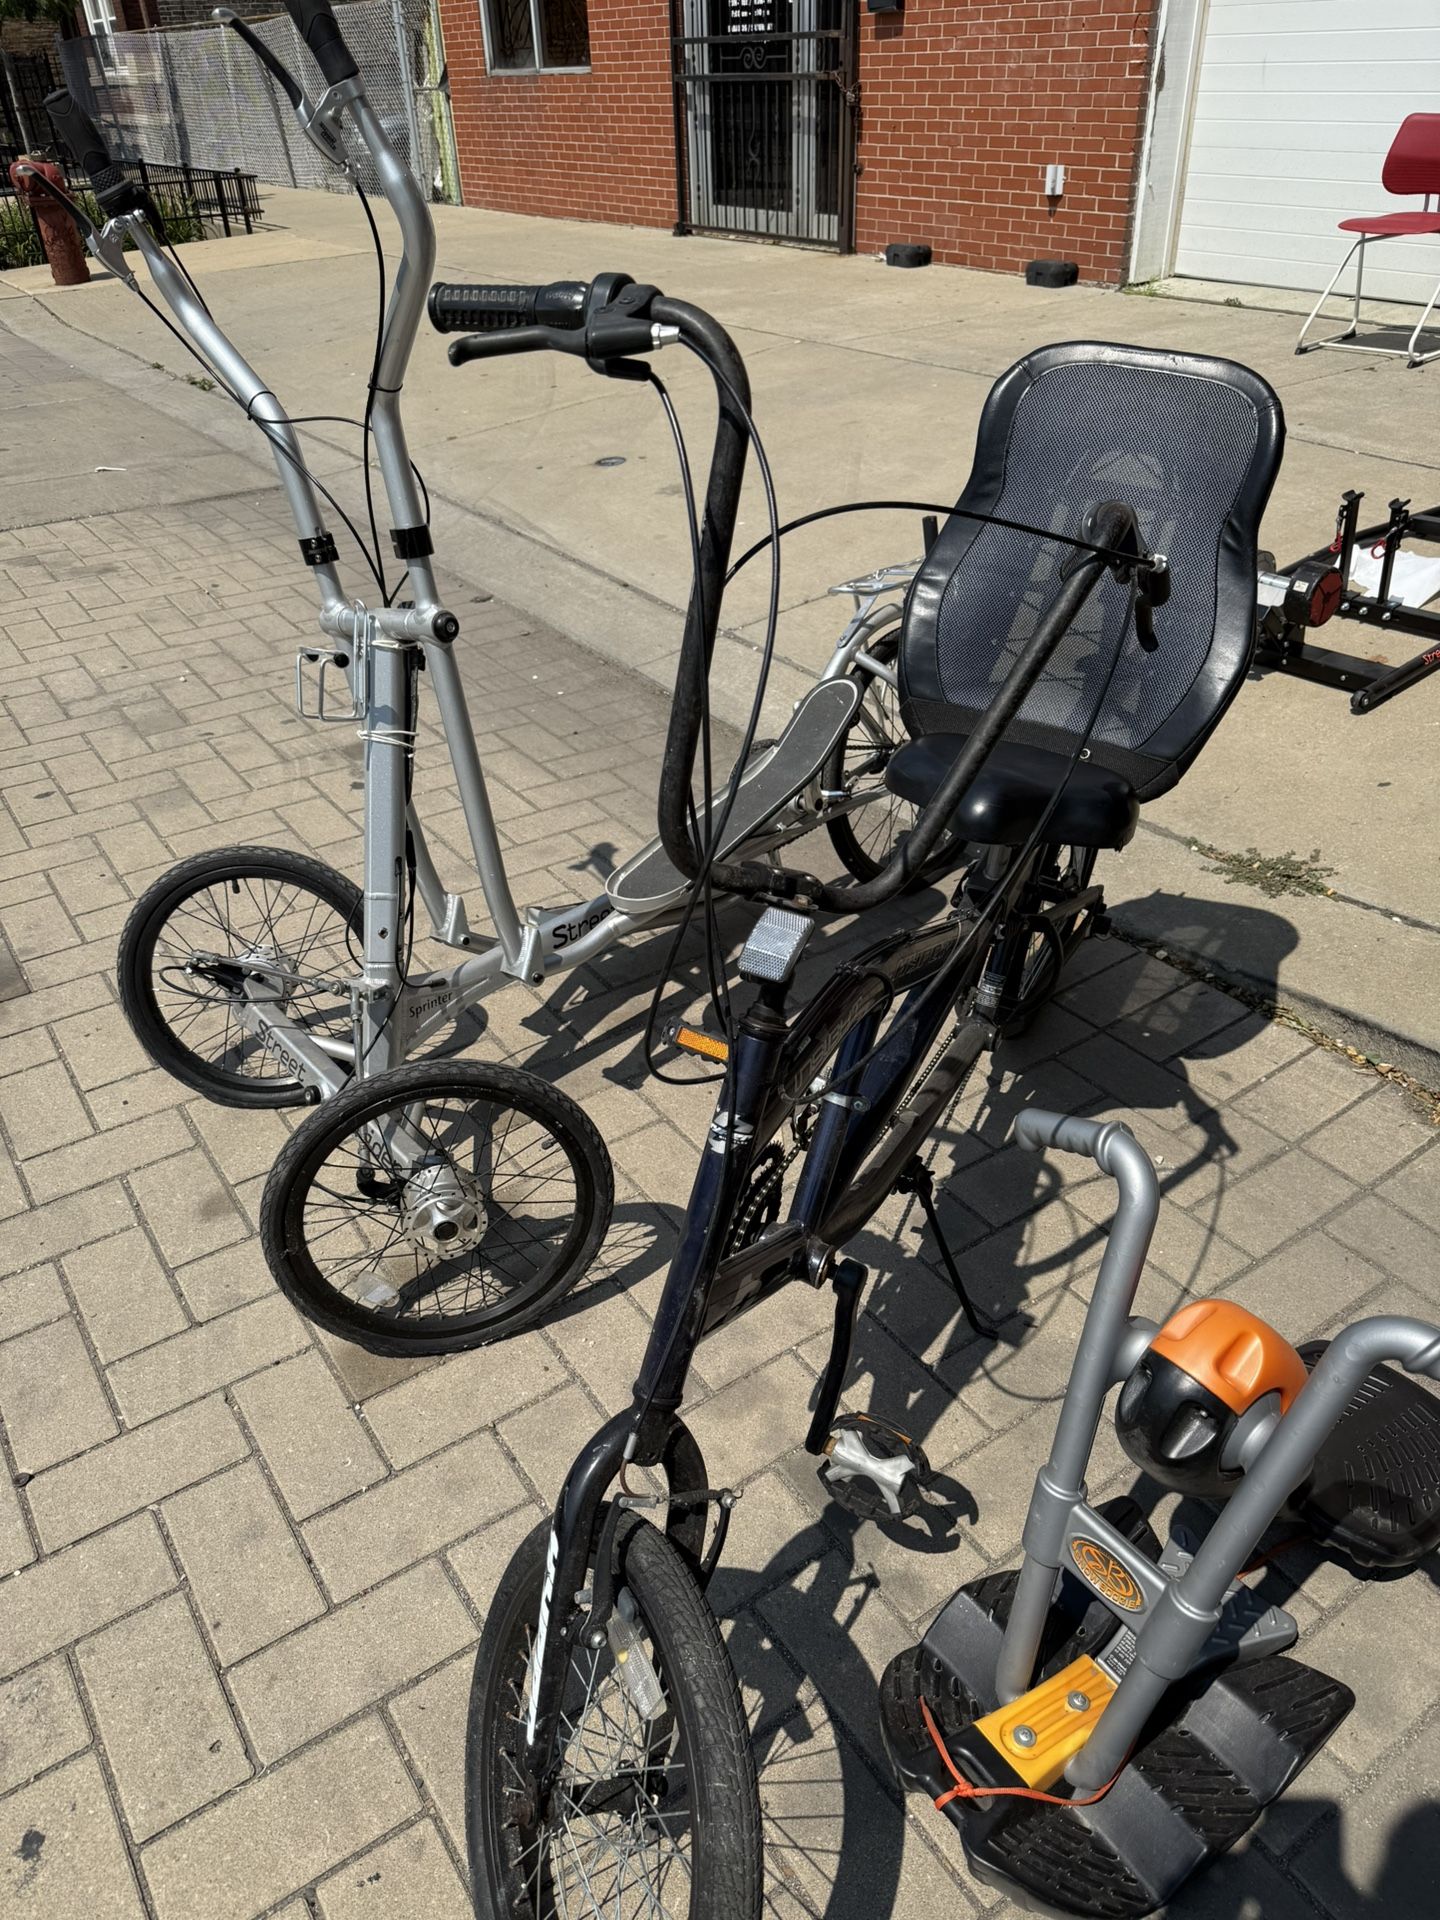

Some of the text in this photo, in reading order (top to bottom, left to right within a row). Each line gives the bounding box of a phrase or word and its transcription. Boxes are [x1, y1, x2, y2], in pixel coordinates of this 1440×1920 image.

[552, 906, 615, 949] Stree
[409, 992, 452, 1018] Sprinter
[255, 1019, 306, 1082] Street
